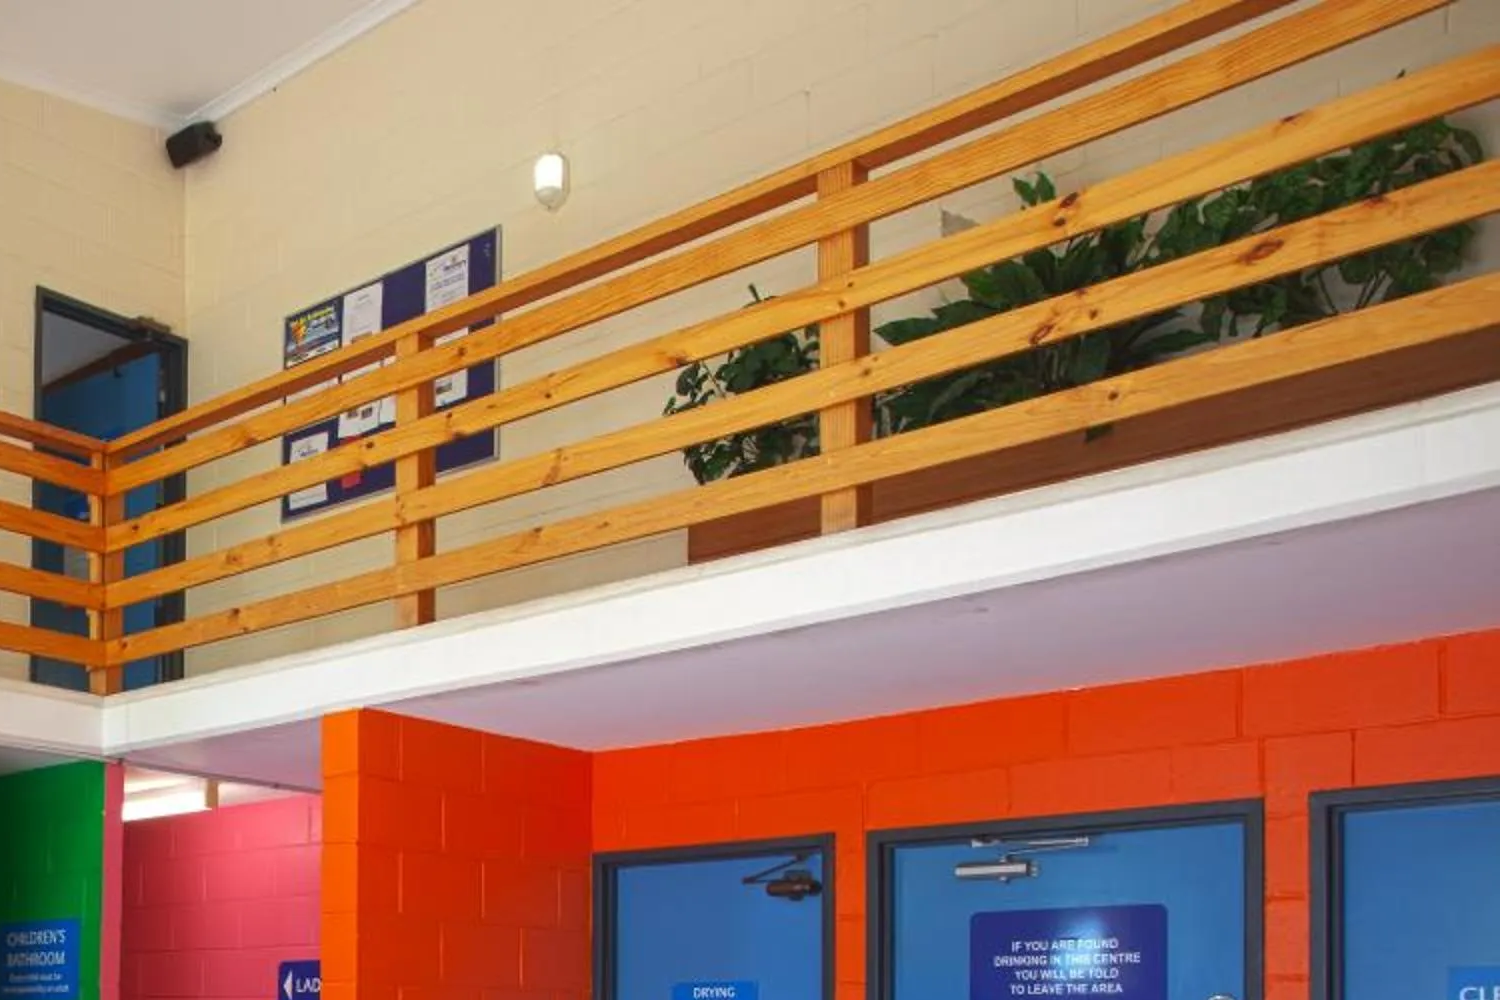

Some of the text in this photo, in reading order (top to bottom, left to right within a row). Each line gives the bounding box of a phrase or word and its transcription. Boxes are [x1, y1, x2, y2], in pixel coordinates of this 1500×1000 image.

[1011, 938, 1119, 952] IF YOU ARE FOUND
[993, 954, 1047, 967] DRINKING
[1093, 952, 1141, 965] CENTRE
[1015, 967, 1119, 981] YOU WILL BE TOLD
[693, 987, 736, 999] DRYING
[1011, 983, 1123, 995] TO LEAVE THE AREA
